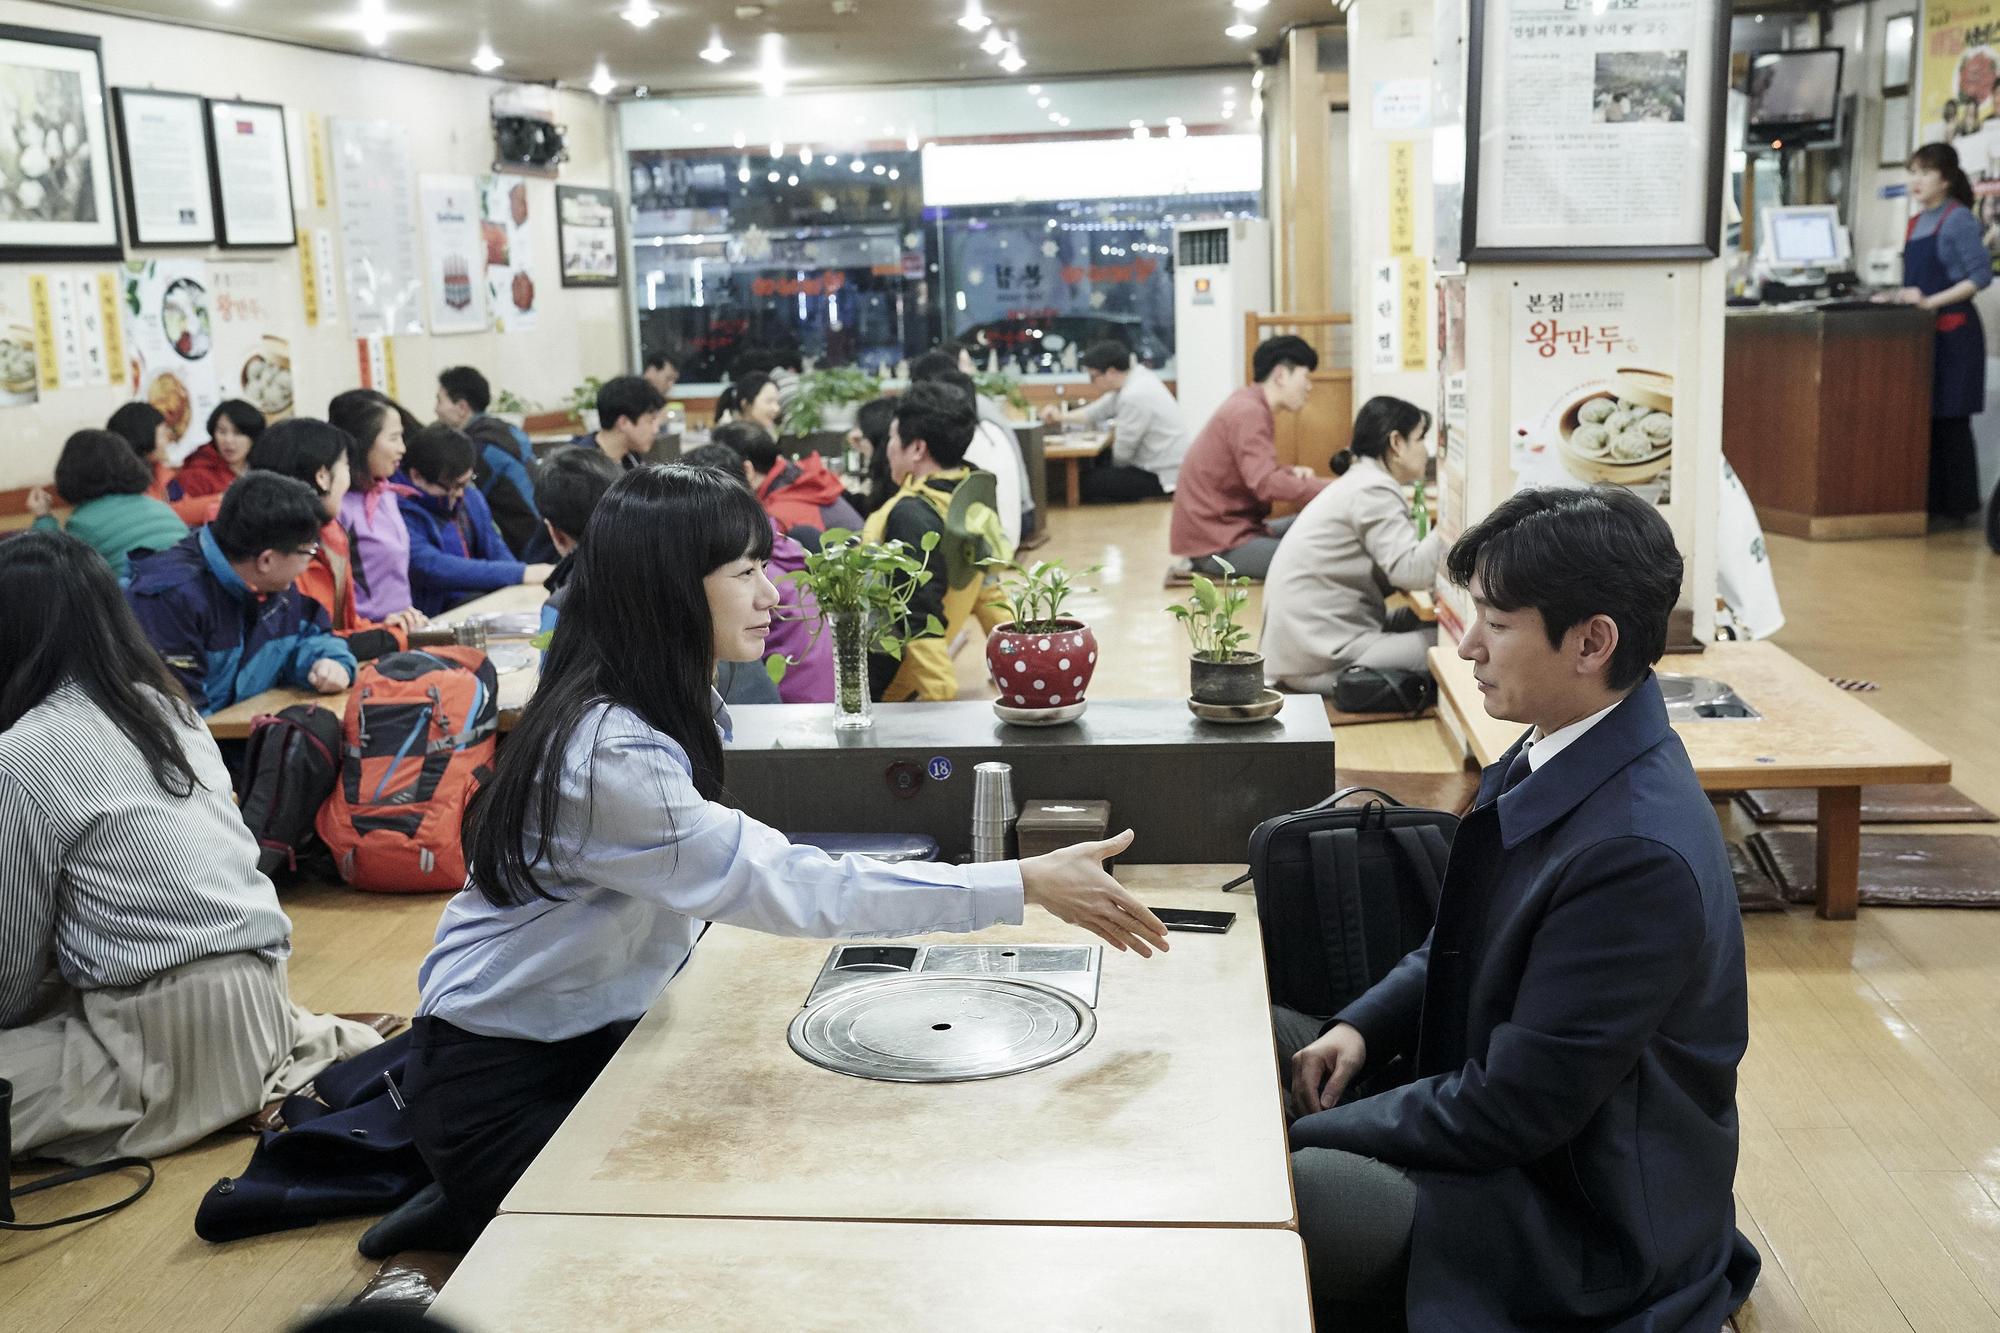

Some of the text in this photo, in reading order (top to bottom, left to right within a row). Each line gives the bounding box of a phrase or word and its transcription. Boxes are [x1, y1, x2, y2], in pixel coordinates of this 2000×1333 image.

[1526, 292, 1563, 313] 본점
[1526, 318, 1624, 358] 왕만두
[932, 760, 949, 776] 18
